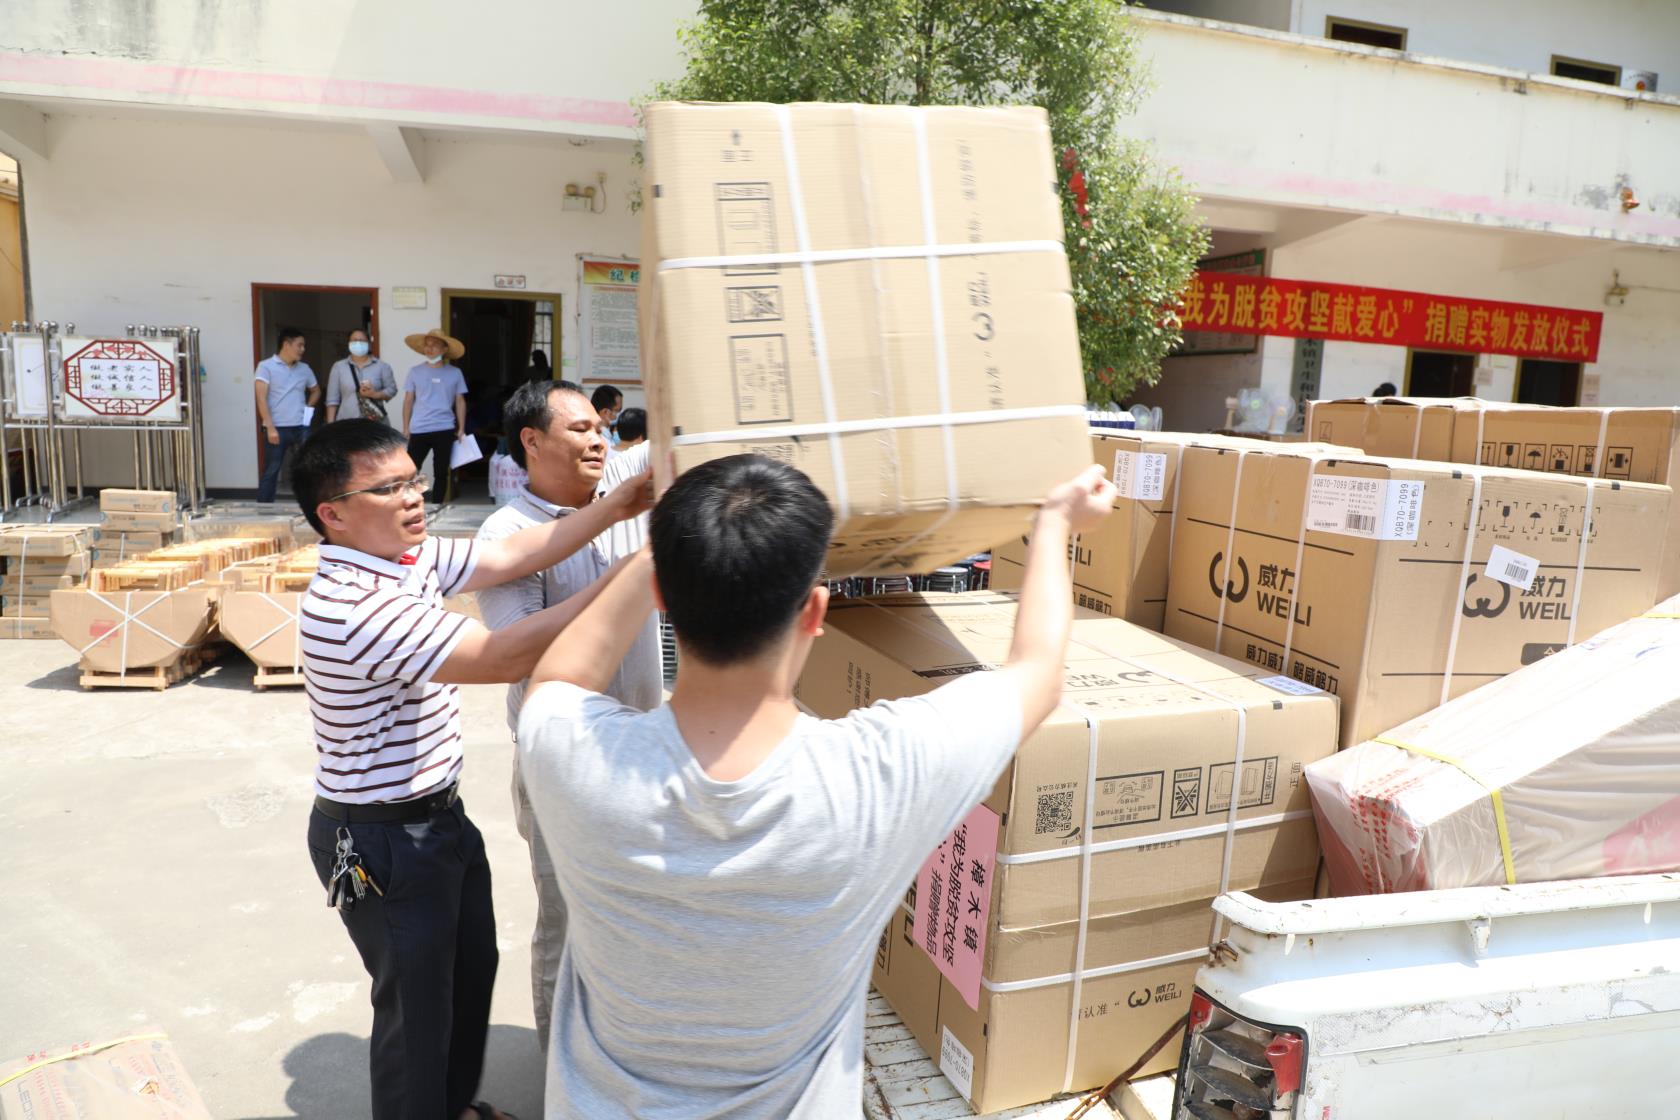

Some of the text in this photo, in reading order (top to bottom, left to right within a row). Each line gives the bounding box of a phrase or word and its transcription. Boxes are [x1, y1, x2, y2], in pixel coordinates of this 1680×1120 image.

[1425, 301, 1592, 357] 捐赠实物发放仪式
[1394, 483, 1410, 538] XQB70-7099
[1067, 543, 1092, 567] EILI
[1257, 564, 1297, 594] 威力
[963, 859, 986, 955] 樟木镇
[1154, 989, 1182, 1004] WEILI
[1155, 982, 1176, 995] 威力
